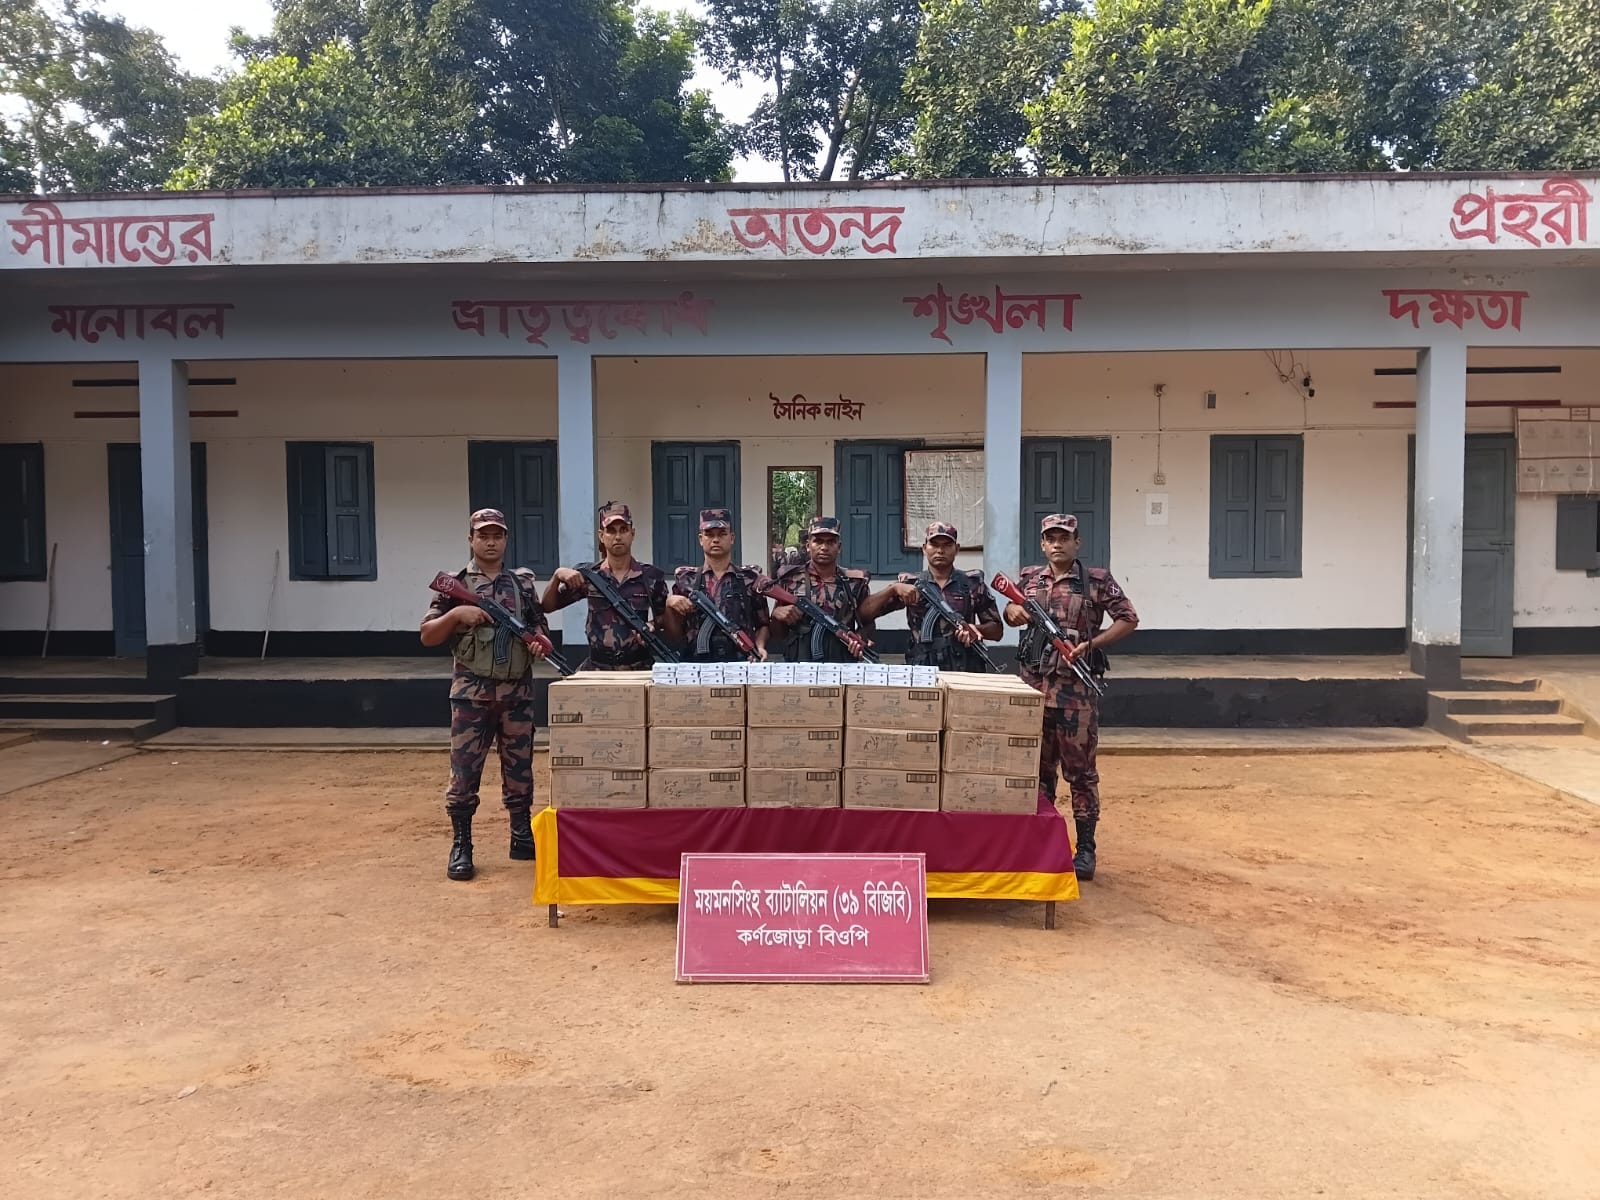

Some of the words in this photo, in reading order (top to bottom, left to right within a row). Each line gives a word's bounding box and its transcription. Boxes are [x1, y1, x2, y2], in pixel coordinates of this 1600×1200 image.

[7, 201, 215, 265] সীমান্তের
[727, 206, 905, 255] অতন্দ্র
[1450, 176, 1594, 247] প্রহরী
[48, 303, 234, 343] মনোবল
[1381, 289, 1530, 332] দক্ষতা
[769, 392, 822, 420] সৈনিক
[824, 394, 865, 420] লাইন
[694, 880, 761, 919] ময়মনসিংহ
[765, 880, 828, 916] ব্যাটালিয়ন
[833, 885, 860, 923] (৩৯
[863, 881, 913, 923] বিজিবি)
[736, 924, 812, 949] কর্ণজোড়া
[818, 924, 870, 947] বিওপি
